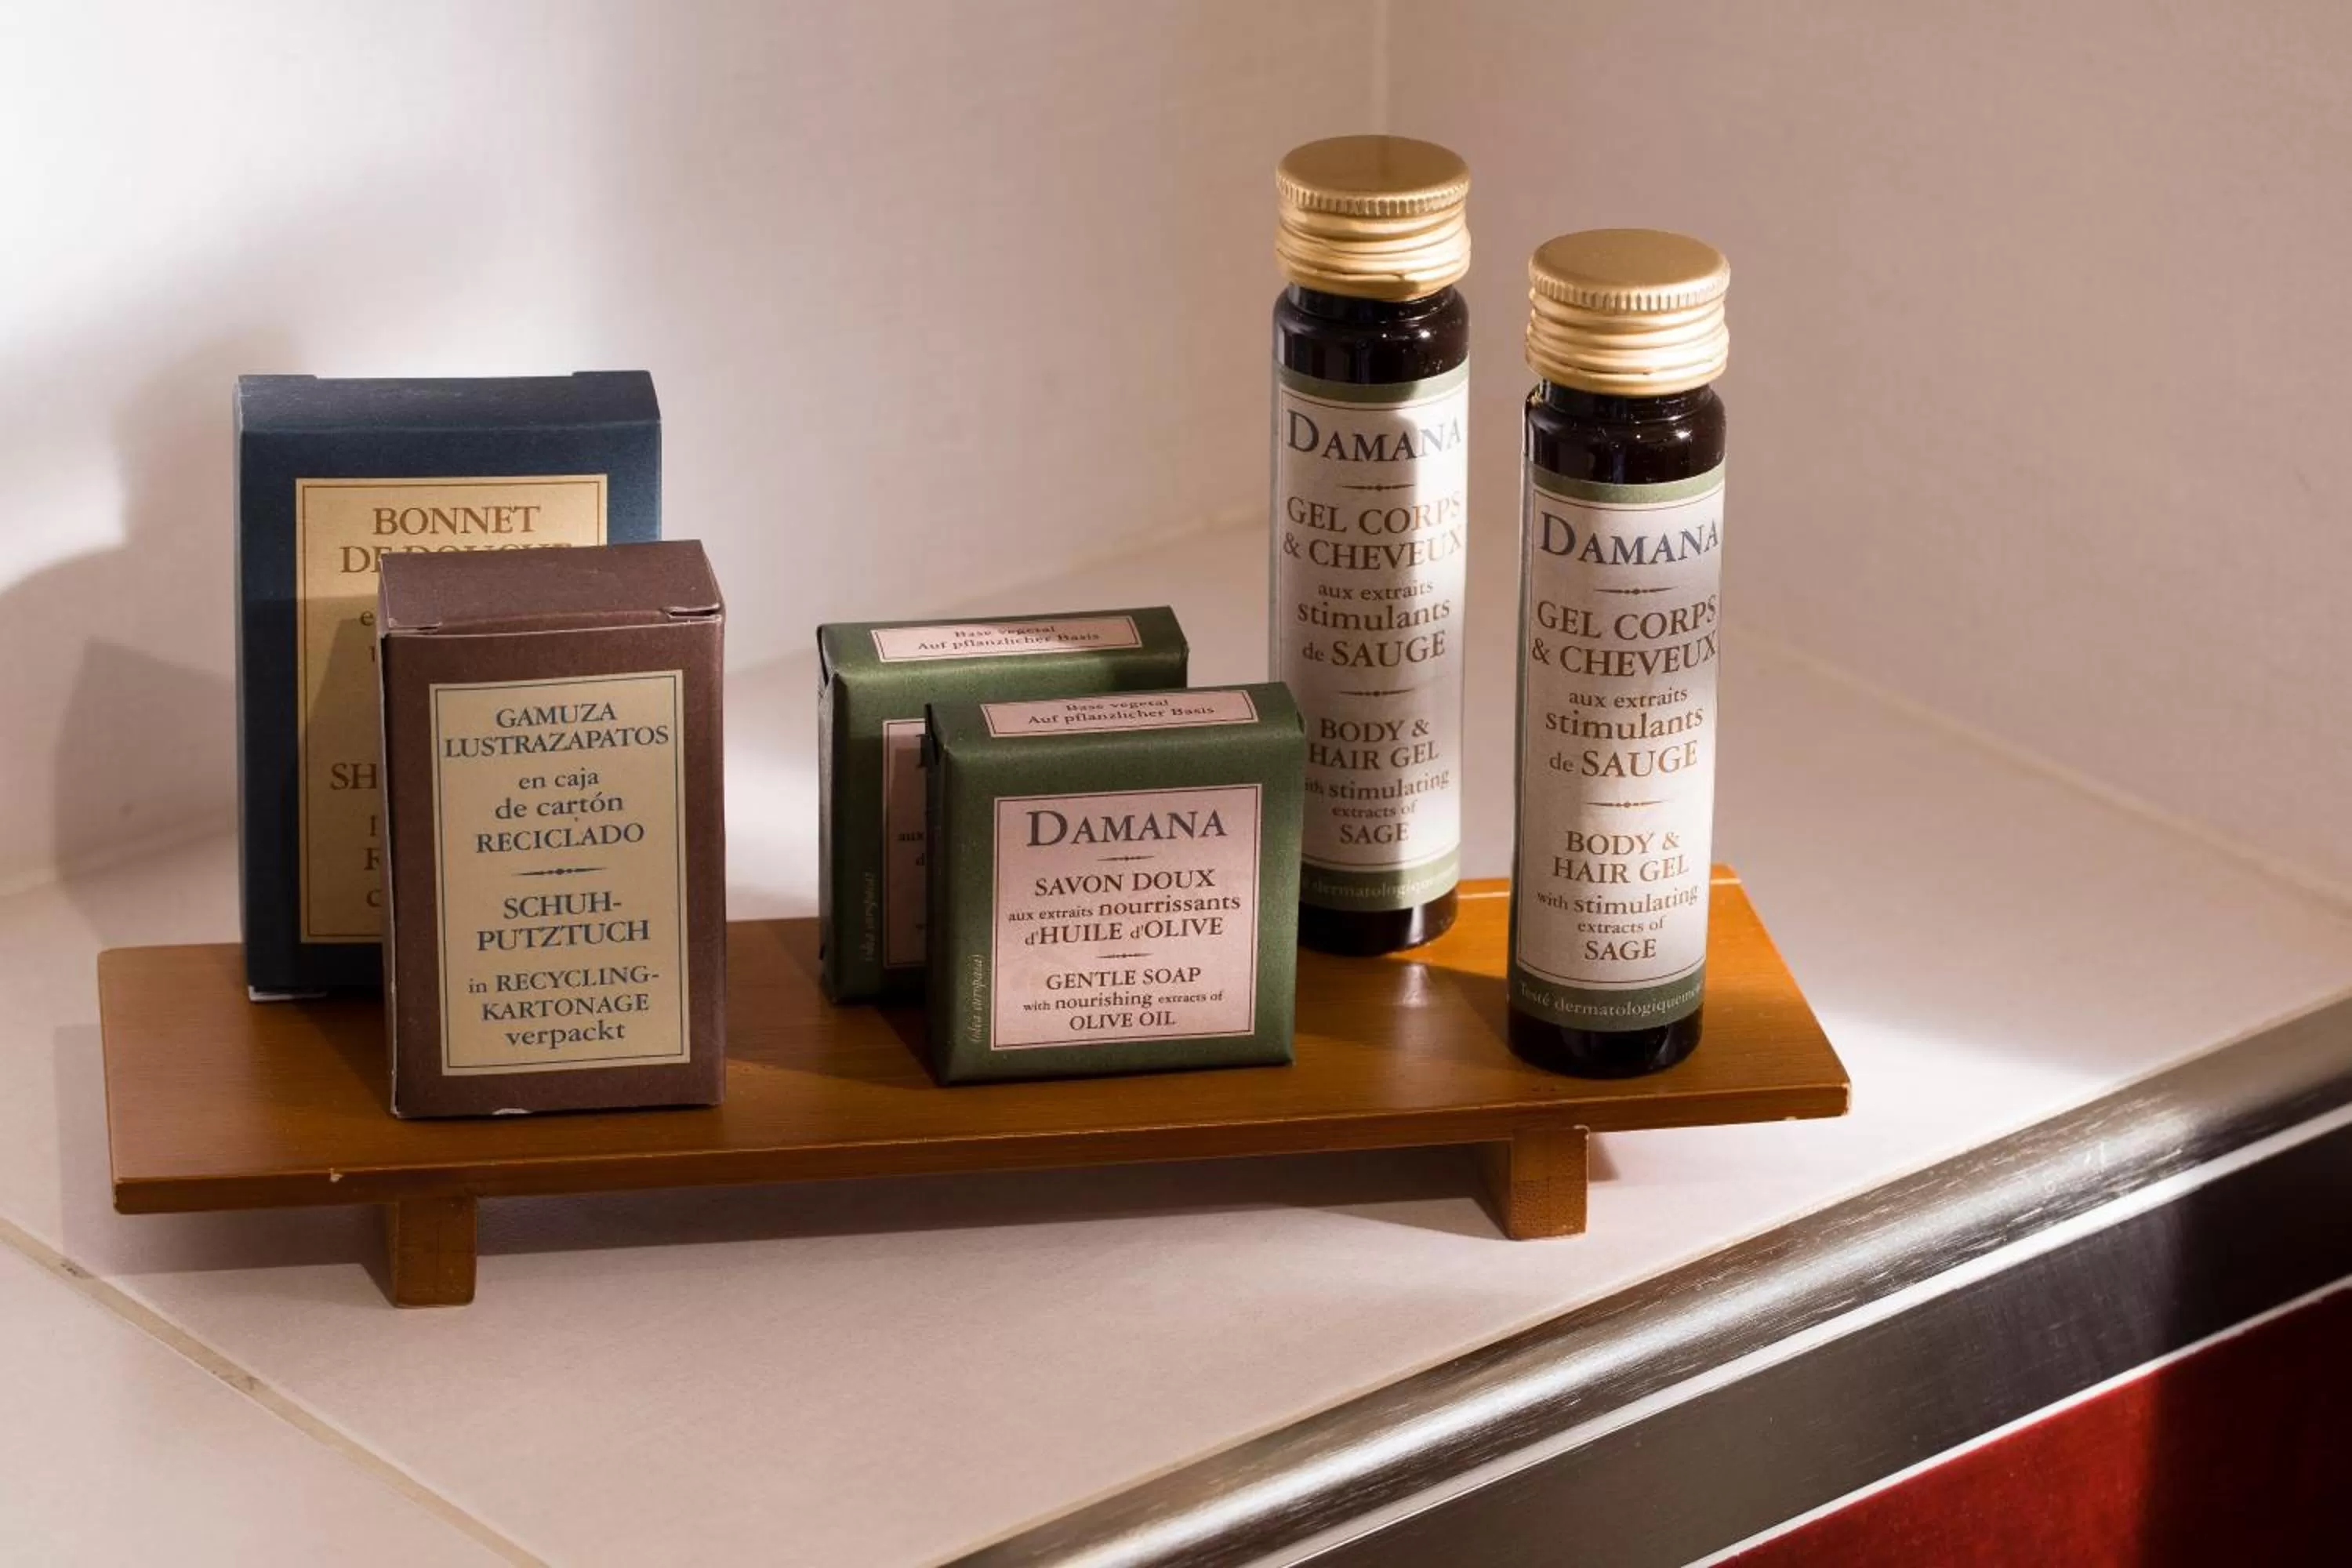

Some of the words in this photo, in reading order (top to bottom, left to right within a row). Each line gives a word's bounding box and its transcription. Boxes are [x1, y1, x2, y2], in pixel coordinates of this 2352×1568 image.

[1287, 408, 1463, 462] DAMANA
[372, 505, 541, 535] BONNET
[1287, 496, 1347, 533] GEL
[1359, 491, 1461, 535] CORPS
[1283, 531, 1301, 559] &
[1308, 525, 1464, 571] CHEVEUX
[1540, 510, 1719, 565] DAMANA
[1318, 583, 1352, 600] aux
[1360, 579, 1435, 601] extraits
[1297, 599, 1450, 631] stimulants
[1537, 601, 1602, 639] GEL
[1614, 594, 1717, 641] CORPS
[918, 641, 947, 650] Auf
[953, 635, 1051, 650] pflanzlicher
[1302, 641, 1324, 662] de
[1331, 630, 1446, 668] SAUGE
[1531, 637, 1551, 666] &
[1559, 630, 1717, 676] CHEVEUX
[1568, 691, 1606, 707] aux
[1613, 687, 1688, 708] extraits
[495, 702, 616, 728] GAMUZA
[1029, 715, 1059, 724] Auf
[1065, 709, 1164, 724] pflanzlicher
[1171, 706, 1214, 716] Basis
[1320, 717, 1405, 742] BODY
[1411, 719, 1430, 737] &
[1545, 706, 1704, 739] stimulants
[445, 725, 670, 757] LUSTRAZAPATOS
[1308, 742, 1381, 770] HAIR
[1390, 741, 1439, 768] GEL
[1549, 753, 1574, 772] de
[1581, 739, 1697, 778] SAUGE
[518, 775, 546, 790] en
[554, 771, 599, 789] caja
[1304, 777, 1324, 796] ith
[1329, 770, 1450, 800] stimulating
[495, 797, 528, 820] de
[537, 792, 623, 816] cartón
[1332, 805, 1396, 819] extracts
[1400, 800, 1418, 815] of
[476, 822, 644, 853] RECICLADO
[1025, 809, 1228, 848] DAMANA
[1340, 823, 1410, 844] SAGE
[1565, 829, 1655, 856] BODY
[1661, 831, 1680, 851] &
[1035, 873, 1123, 896] SAVON
[1132, 868, 1216, 891] DOUX
[1552, 855, 1631, 884] HAIR
[1639, 854, 1690, 883] GEL
[503, 891, 622, 920] SCHUH-
[1008, 911, 1034, 922] aux
[1039, 906, 1094, 920] extraits
[1098, 894, 1240, 916] nourrissants
[1535, 890, 1568, 911] with
[1573, 884, 1700, 916] stimulating
[477, 920, 650, 952] PUTZTUCH
[1025, 922, 1123, 946] d'HUILE
[1130, 917, 1223, 939] d'OLIVE
[1577, 919, 1644, 933] extracts
[1649, 915, 1666, 931] of
[1584, 938, 1657, 961] SAGE
[469, 978, 487, 993] in
[495, 964, 659, 992] RECYCLING-
[1046, 970, 1136, 990] GENTLE
[1142, 967, 1202, 985] SOAP
[481, 993, 649, 1022] KARTONAGE
[1023, 1000, 1051, 1011] with
[1054, 990, 1152, 1010] nourishing
[1158, 993, 1207, 1004] extracts
[1210, 990, 1222, 1001] of
[505, 1021, 626, 1049] verpackt
[1069, 1012, 1133, 1031] OLIVE
[1139, 1011, 1177, 1028] OIL
